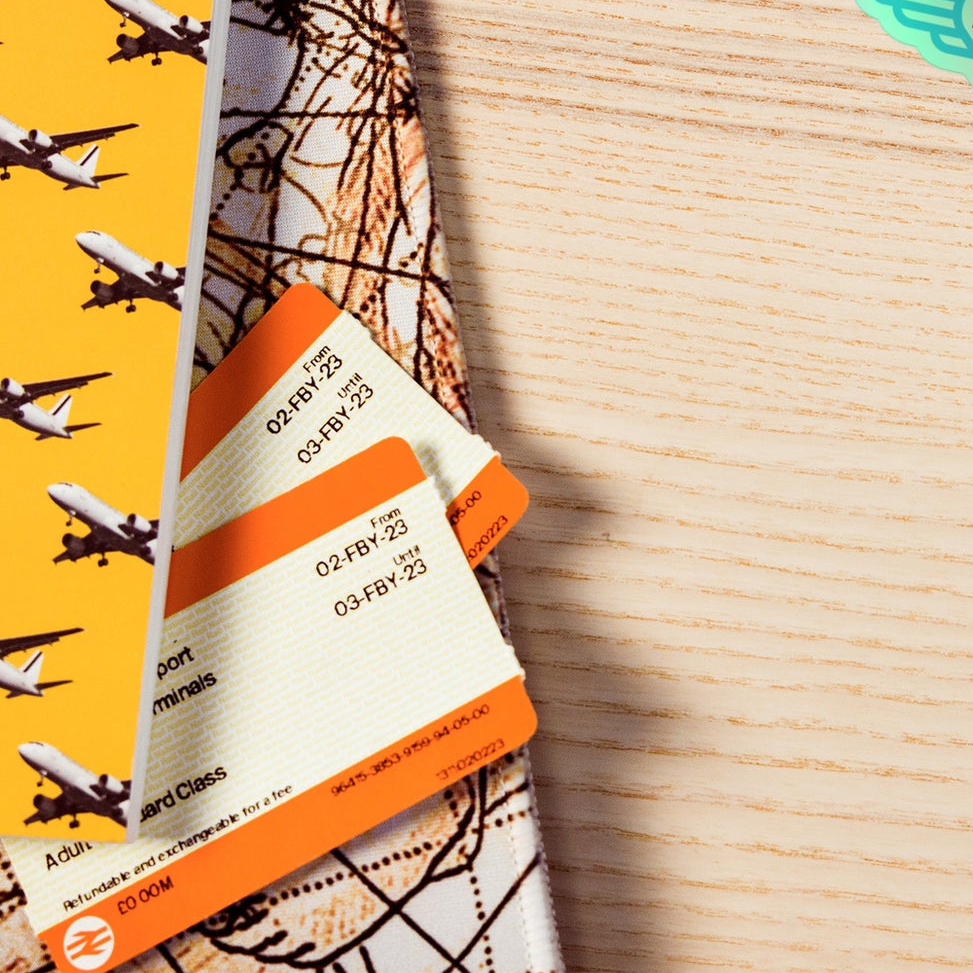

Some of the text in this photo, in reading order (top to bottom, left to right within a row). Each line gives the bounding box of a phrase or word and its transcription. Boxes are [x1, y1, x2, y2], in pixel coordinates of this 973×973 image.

[302, 344, 332, 374] From
[266, 354, 343, 435] 02-FBY-23
[336, 372, 363, 399] Until
[297, 384, 374, 464] 03-FBY-23
[370, 506, 402, 530] From
[315, 518, 409, 578] 02-FBY-23
[393, 544, 421, 567] Until
[334, 558, 428, 617] 03-FBY-23
[176, 765, 228, 801] Class
[63, 784, 294, 912] Refundable and exchangeable for a fee
